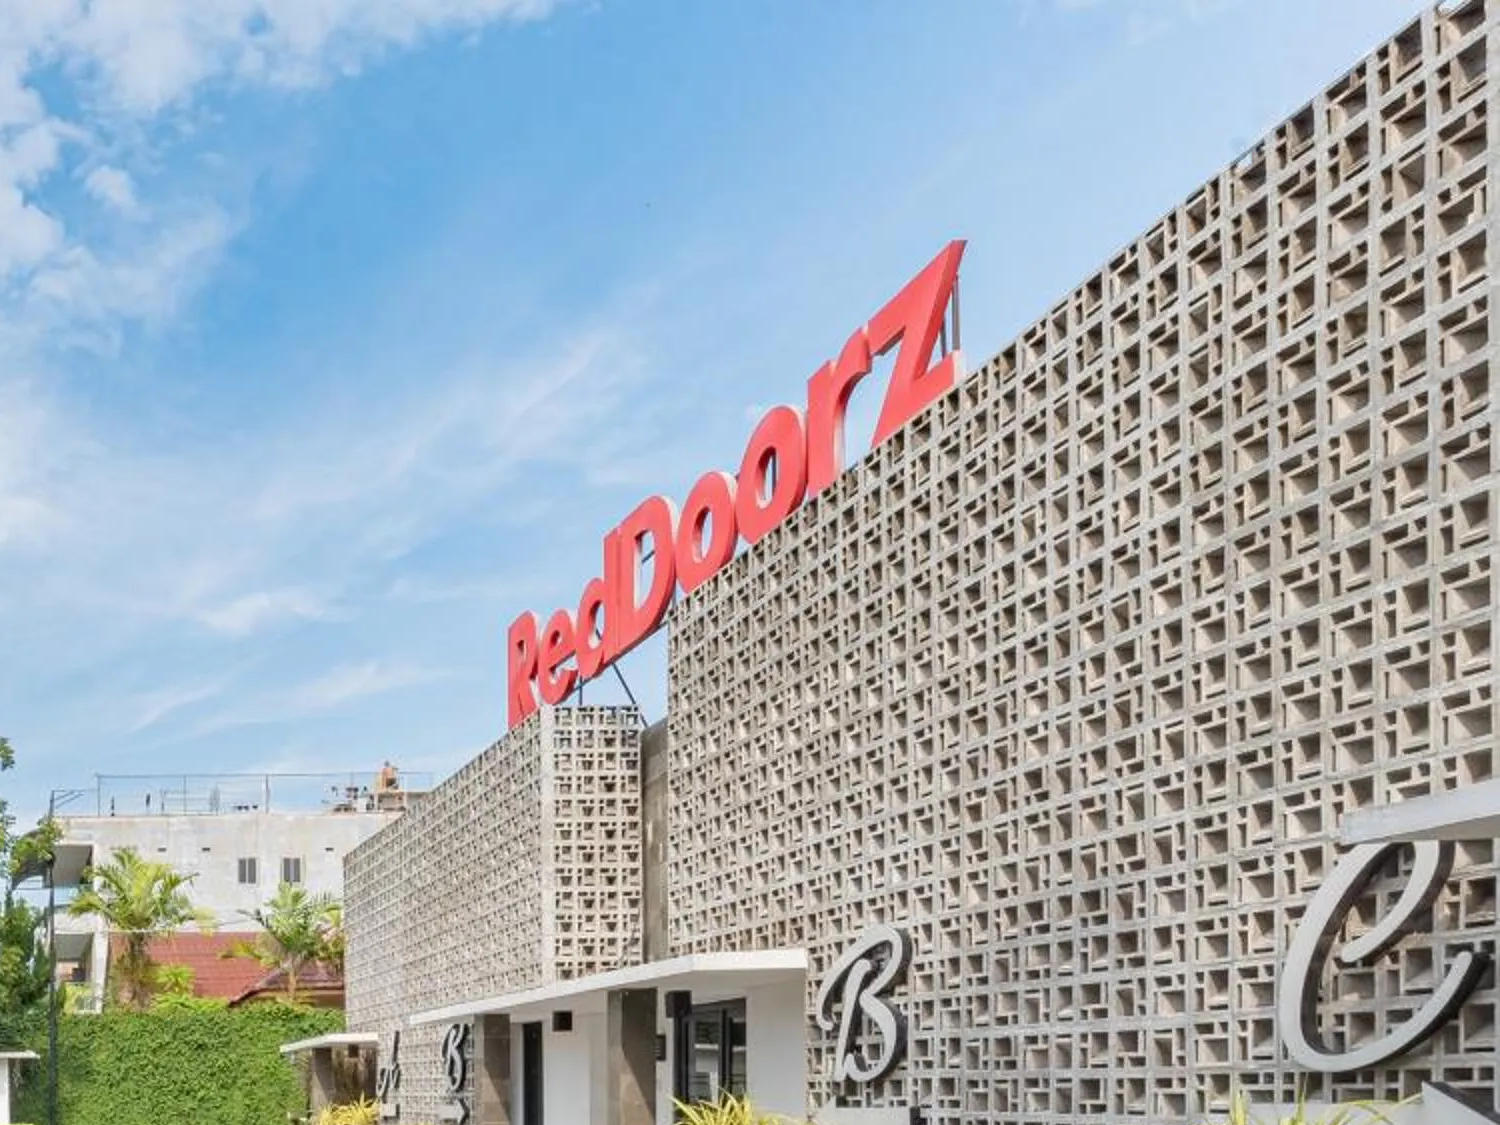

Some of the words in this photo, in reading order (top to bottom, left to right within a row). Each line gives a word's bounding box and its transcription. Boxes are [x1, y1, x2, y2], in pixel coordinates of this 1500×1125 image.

[508, 240, 966, 730] RedDoorz
[816, 925, 912, 1083] B
[1280, 840, 1482, 1073] C
[442, 1023, 468, 1093] B
